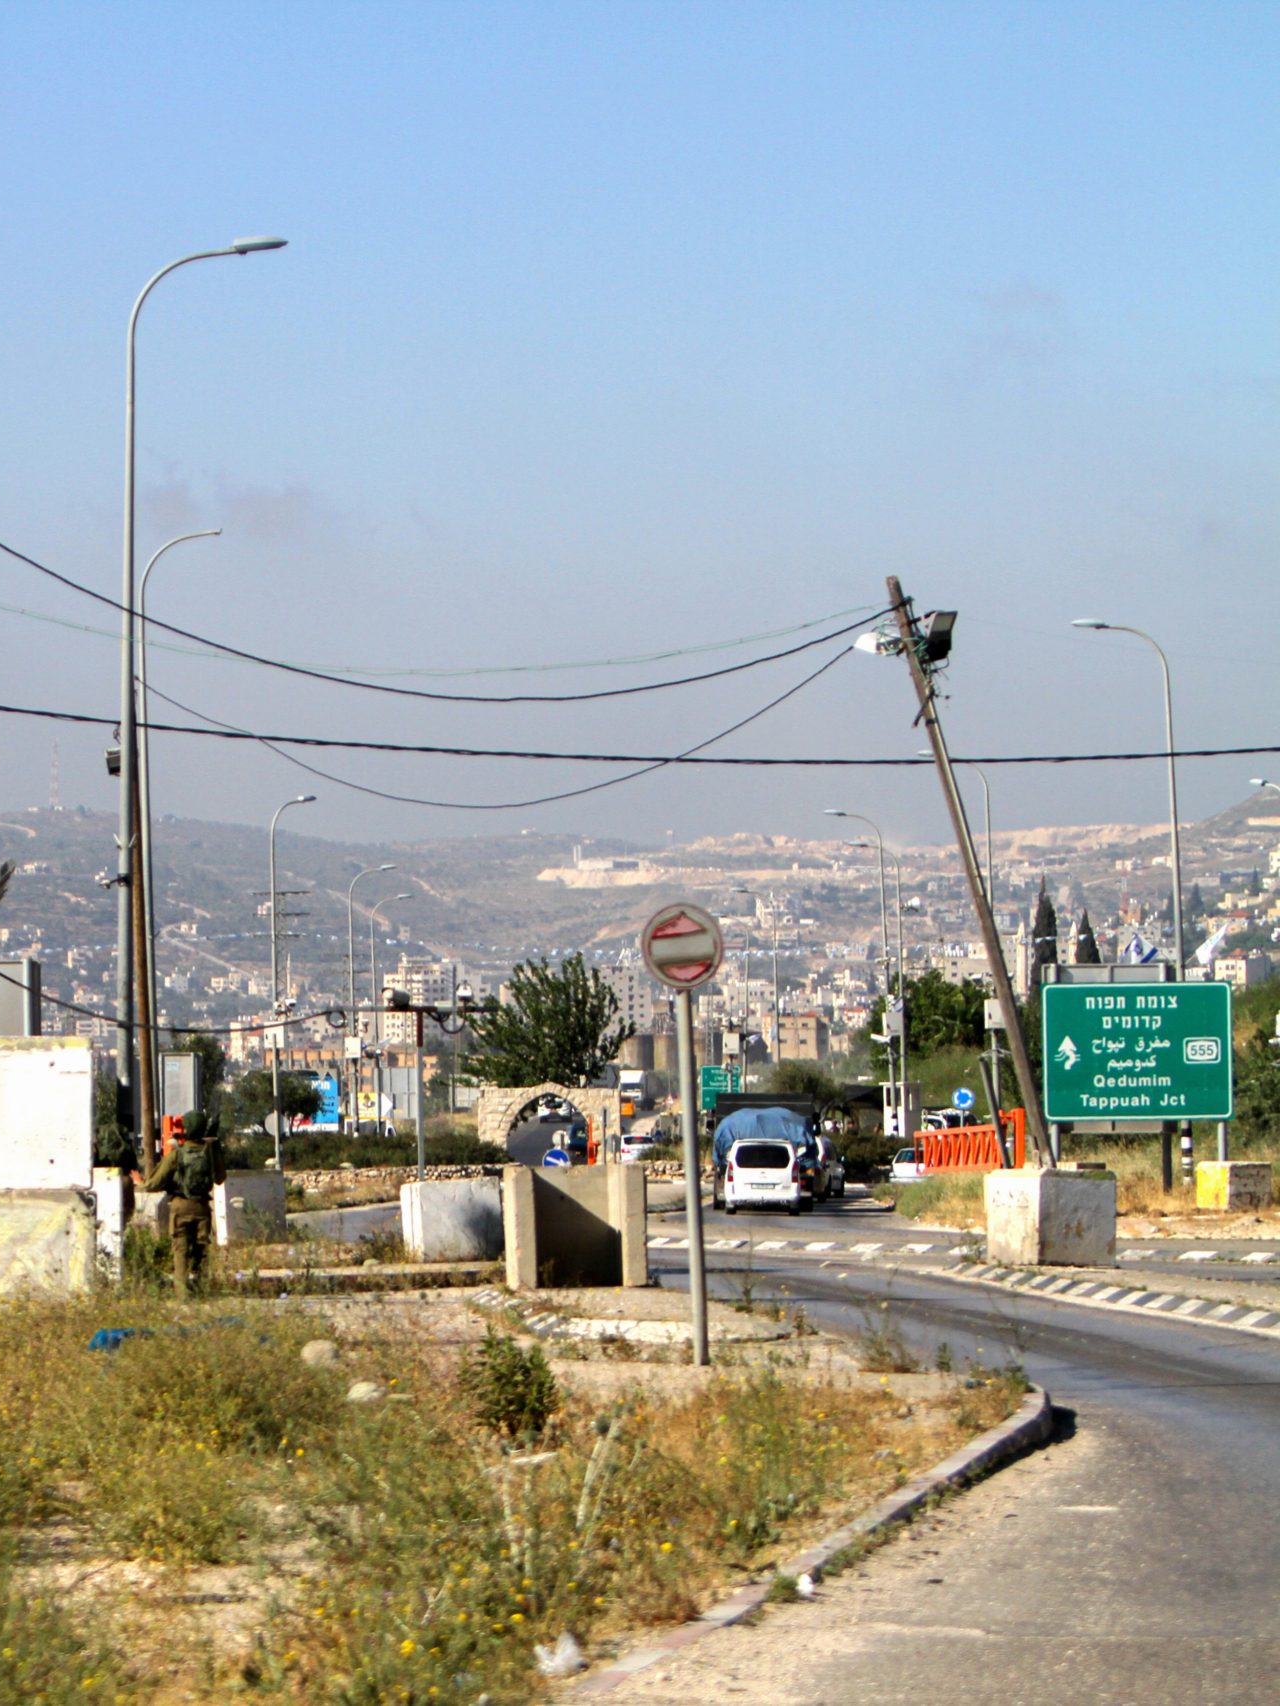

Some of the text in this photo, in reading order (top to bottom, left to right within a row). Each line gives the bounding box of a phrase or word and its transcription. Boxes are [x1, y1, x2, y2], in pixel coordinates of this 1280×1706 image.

[1085, 995, 1178, 1009] צומת תפוח
[1102, 1015, 1162, 1030] קדומים
[1134, 1036, 1171, 1052] مفرق
[1190, 1044, 1214, 1056] 555
[1093, 1074, 1171, 1088] Qedumim
[1080, 1093, 1186, 1109] Tappuah Jct
